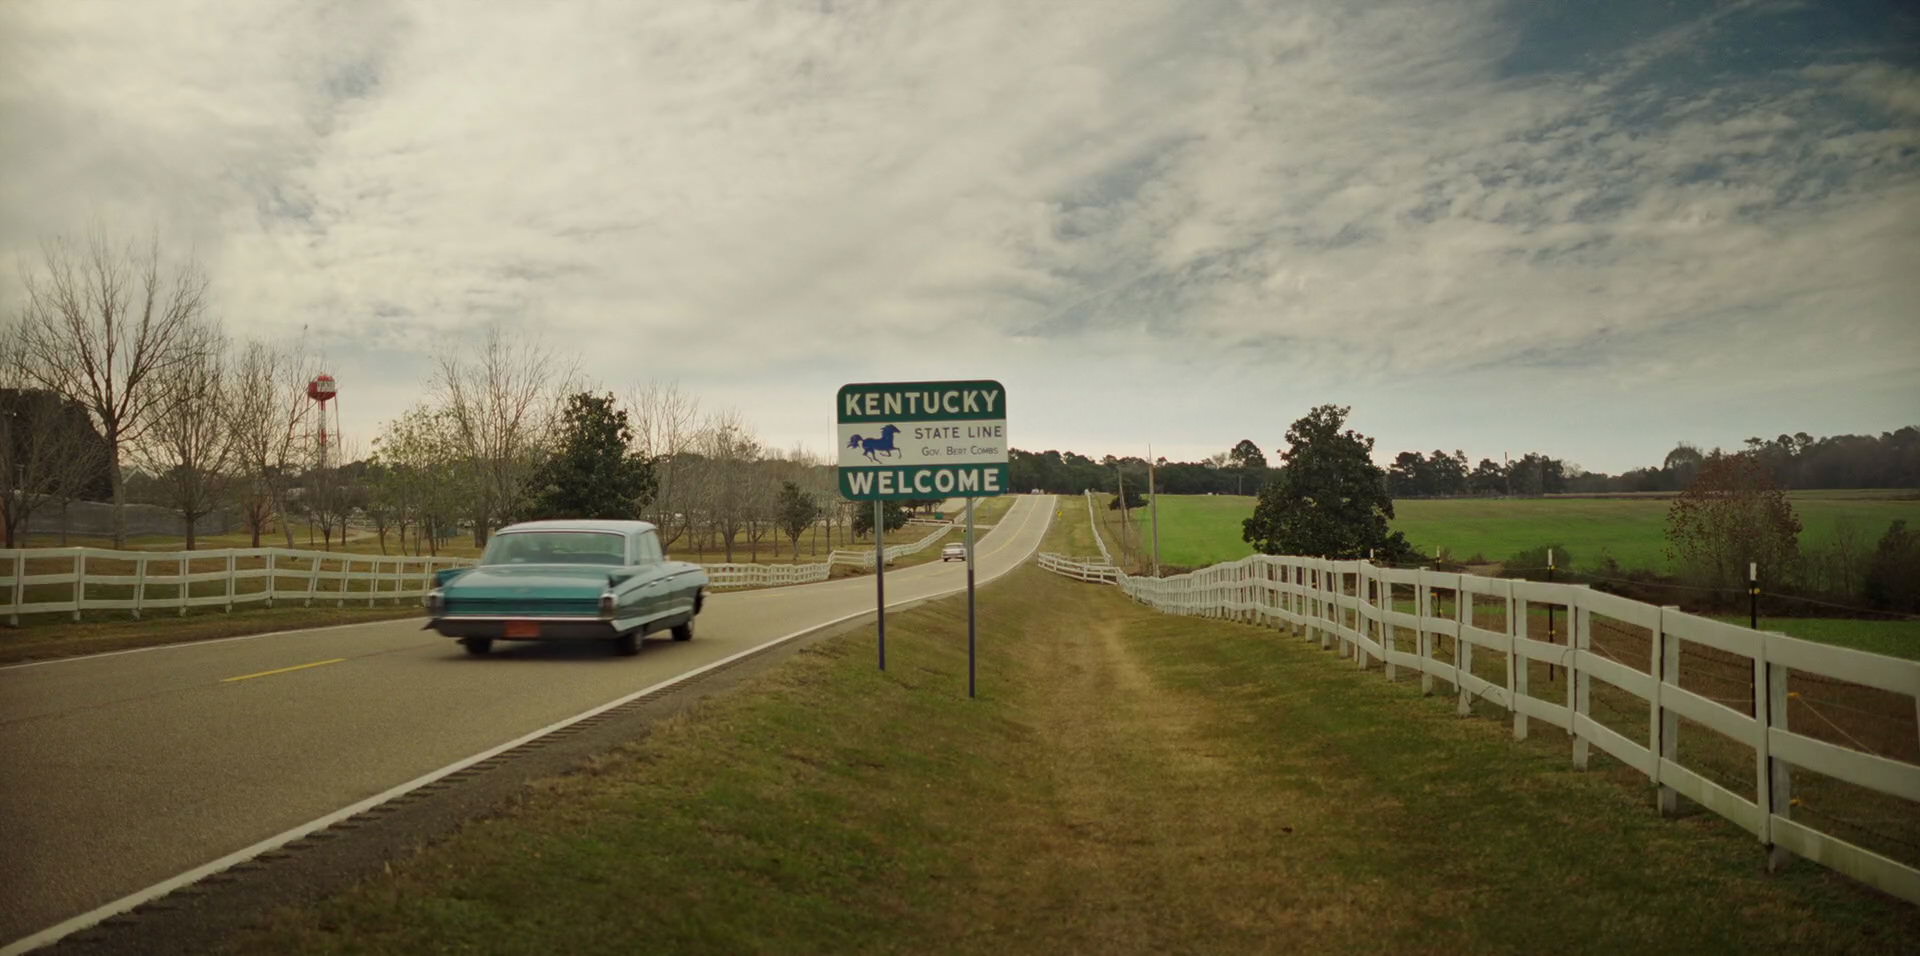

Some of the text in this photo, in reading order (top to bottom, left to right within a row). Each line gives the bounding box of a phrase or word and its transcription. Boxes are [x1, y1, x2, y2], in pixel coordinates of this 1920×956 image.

[846, 390, 999, 416] KENTUCKY
[914, 426, 1003, 440] STATE LINE
[847, 468, 1000, 495] WELCOME
